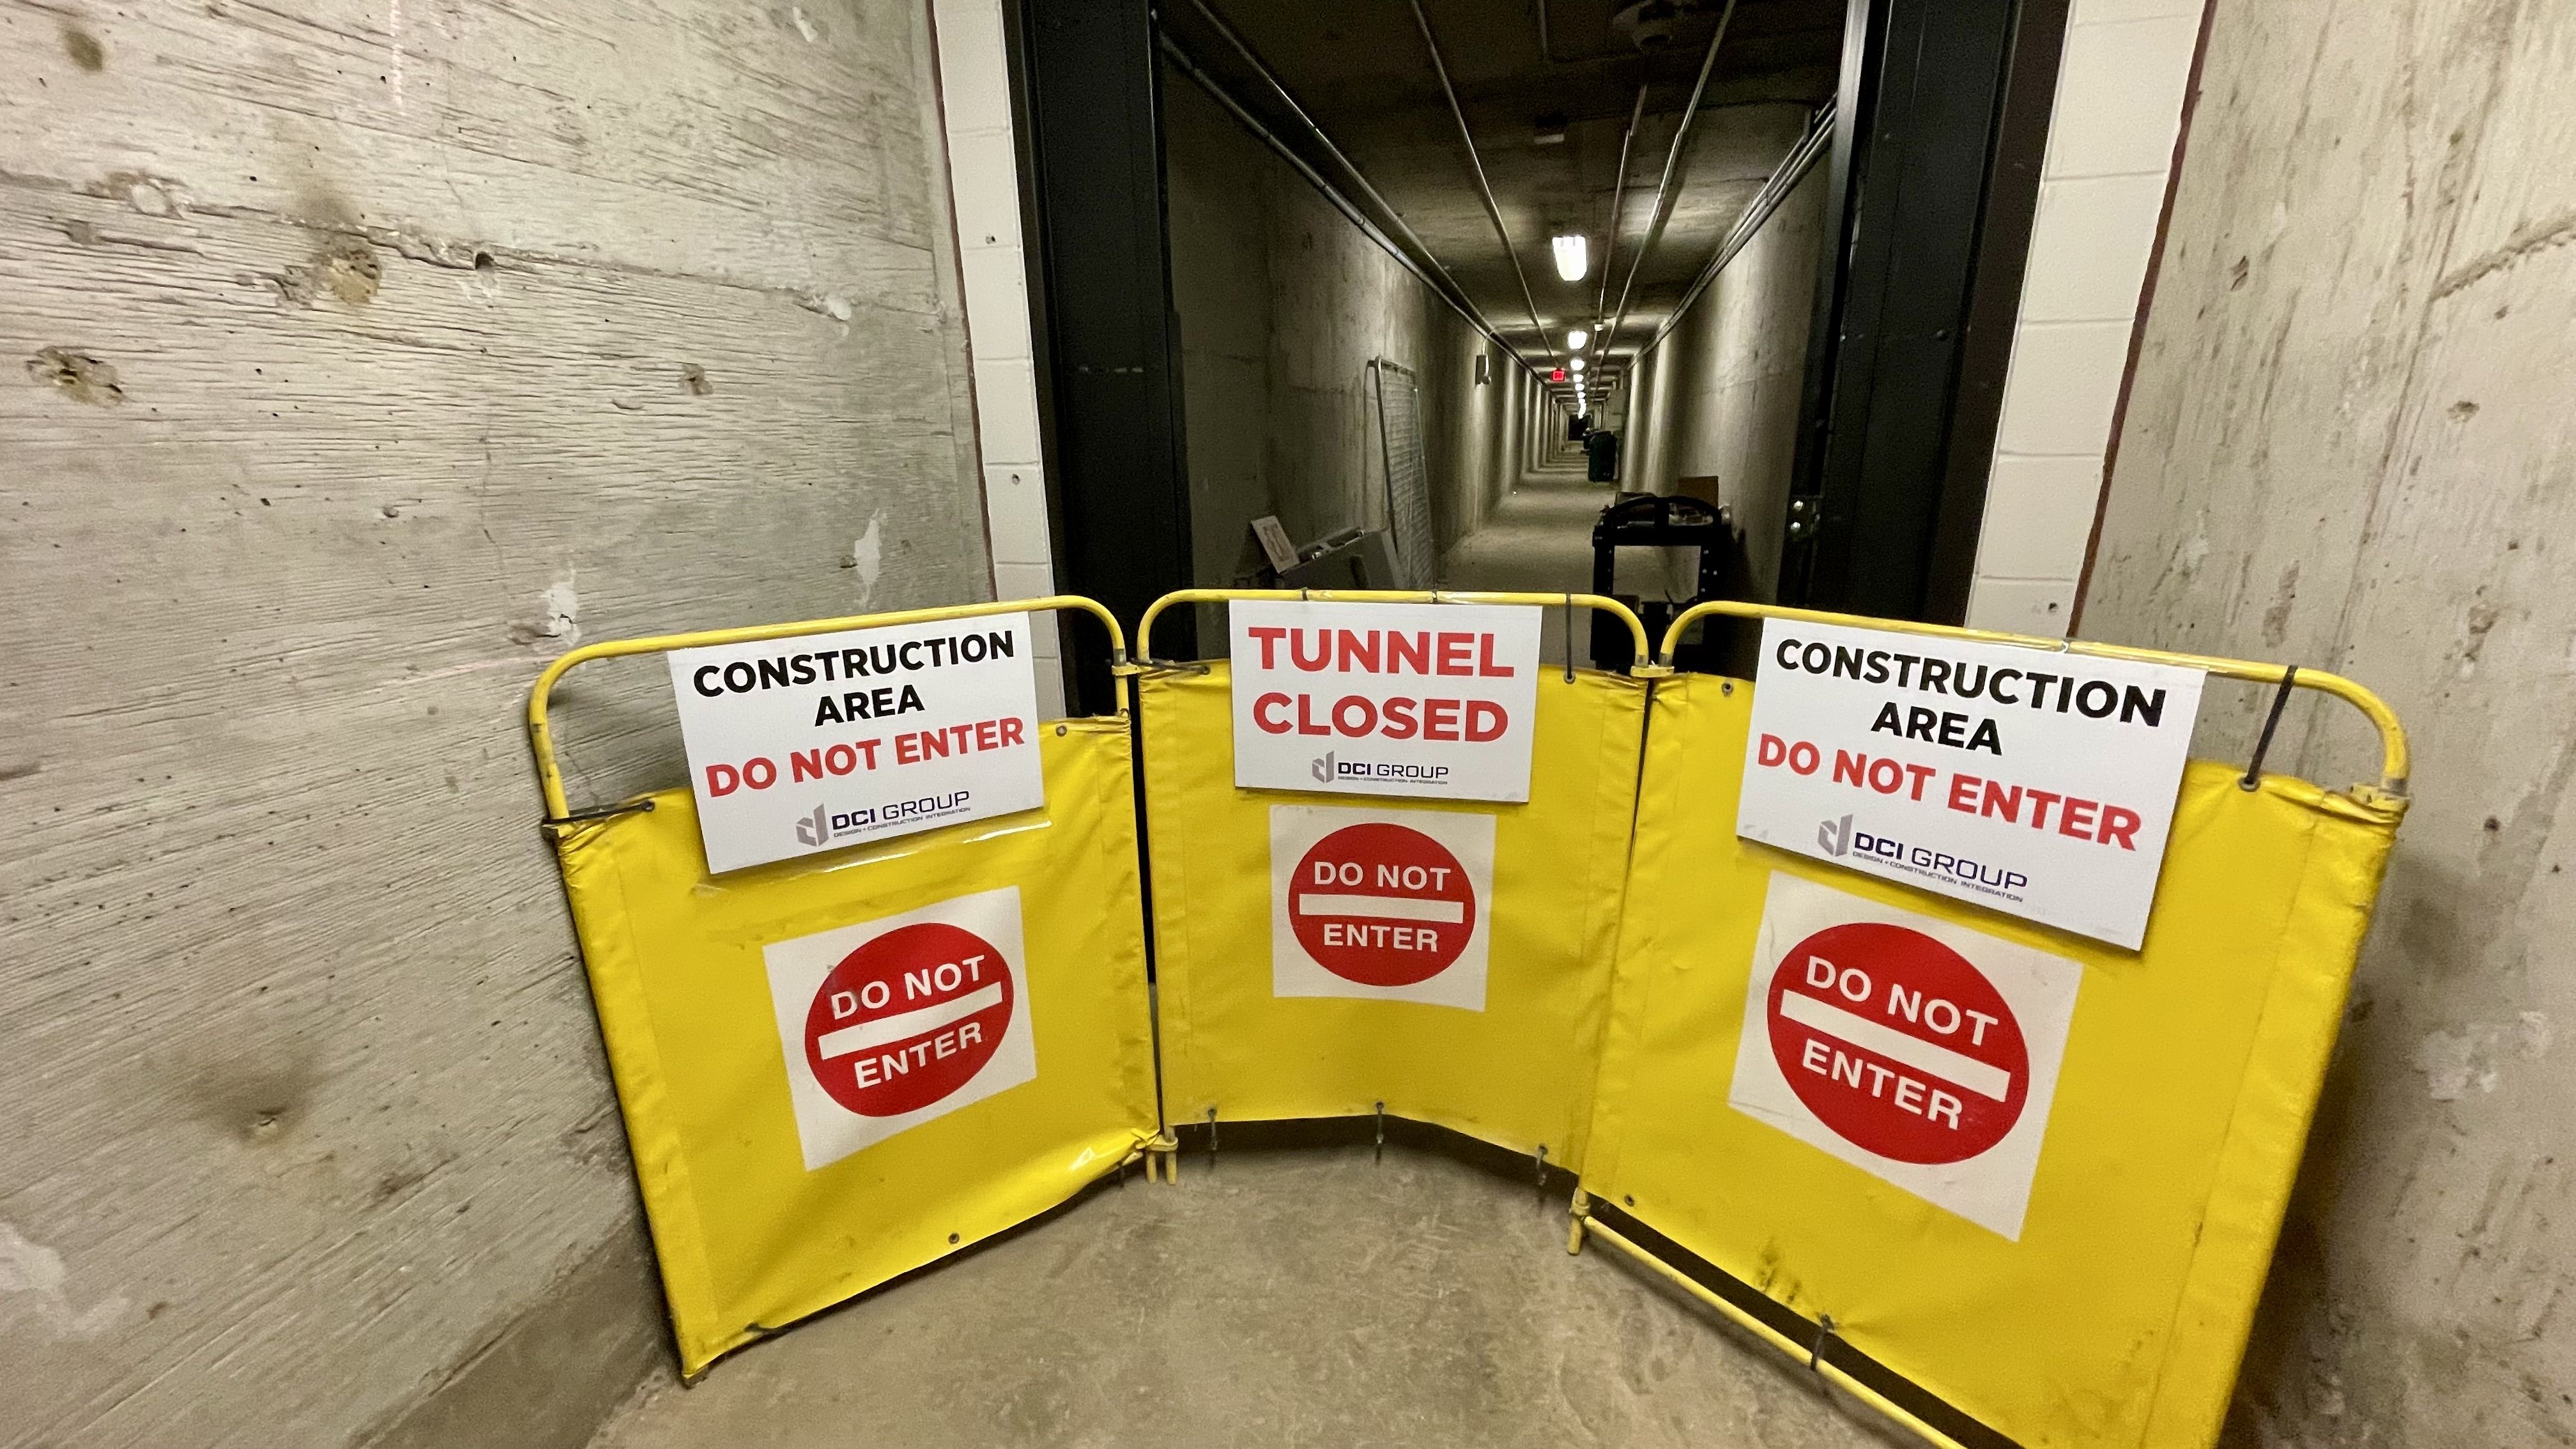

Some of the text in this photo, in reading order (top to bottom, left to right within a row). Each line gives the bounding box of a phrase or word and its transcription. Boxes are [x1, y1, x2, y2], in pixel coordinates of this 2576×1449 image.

[694, 630, 1014, 697] CONSTRUCTION
[1248, 627, 1514, 677] TUNNEL
[814, 684, 924, 726] AREA
[1776, 639, 2166, 727] CONSTRUCTION
[1254, 692, 1508, 742] CLOSED
[1871, 702, 2002, 756] AREA
[705, 717, 1024, 797] DO NOT ENTER
[1338, 762, 1448, 778] DCI GROUP
[832, 791, 969, 830] DCI GROUP
[868, 816, 923, 831] CONSTRUCTION
[926, 807, 970, 819] INTEGRATION
[1758, 733, 2142, 851] DO NOT ENTER
[1314, 862, 1450, 891] DO NOT
[1853, 851, 1883, 864] DESIGN
[1890, 862, 1957, 884] CONSTRUCTION
[1961, 880, 2023, 902] INTEGRATION
[1854, 832, 2028, 889] DCI GROUP
[1324, 924, 1438, 952] ENTER
[831, 954, 985, 1020] DO NOT
[1806, 955, 1998, 1046] DO NOT
[854, 1022, 981, 1089] ENTER
[1802, 1038, 1963, 1130] ENTER
